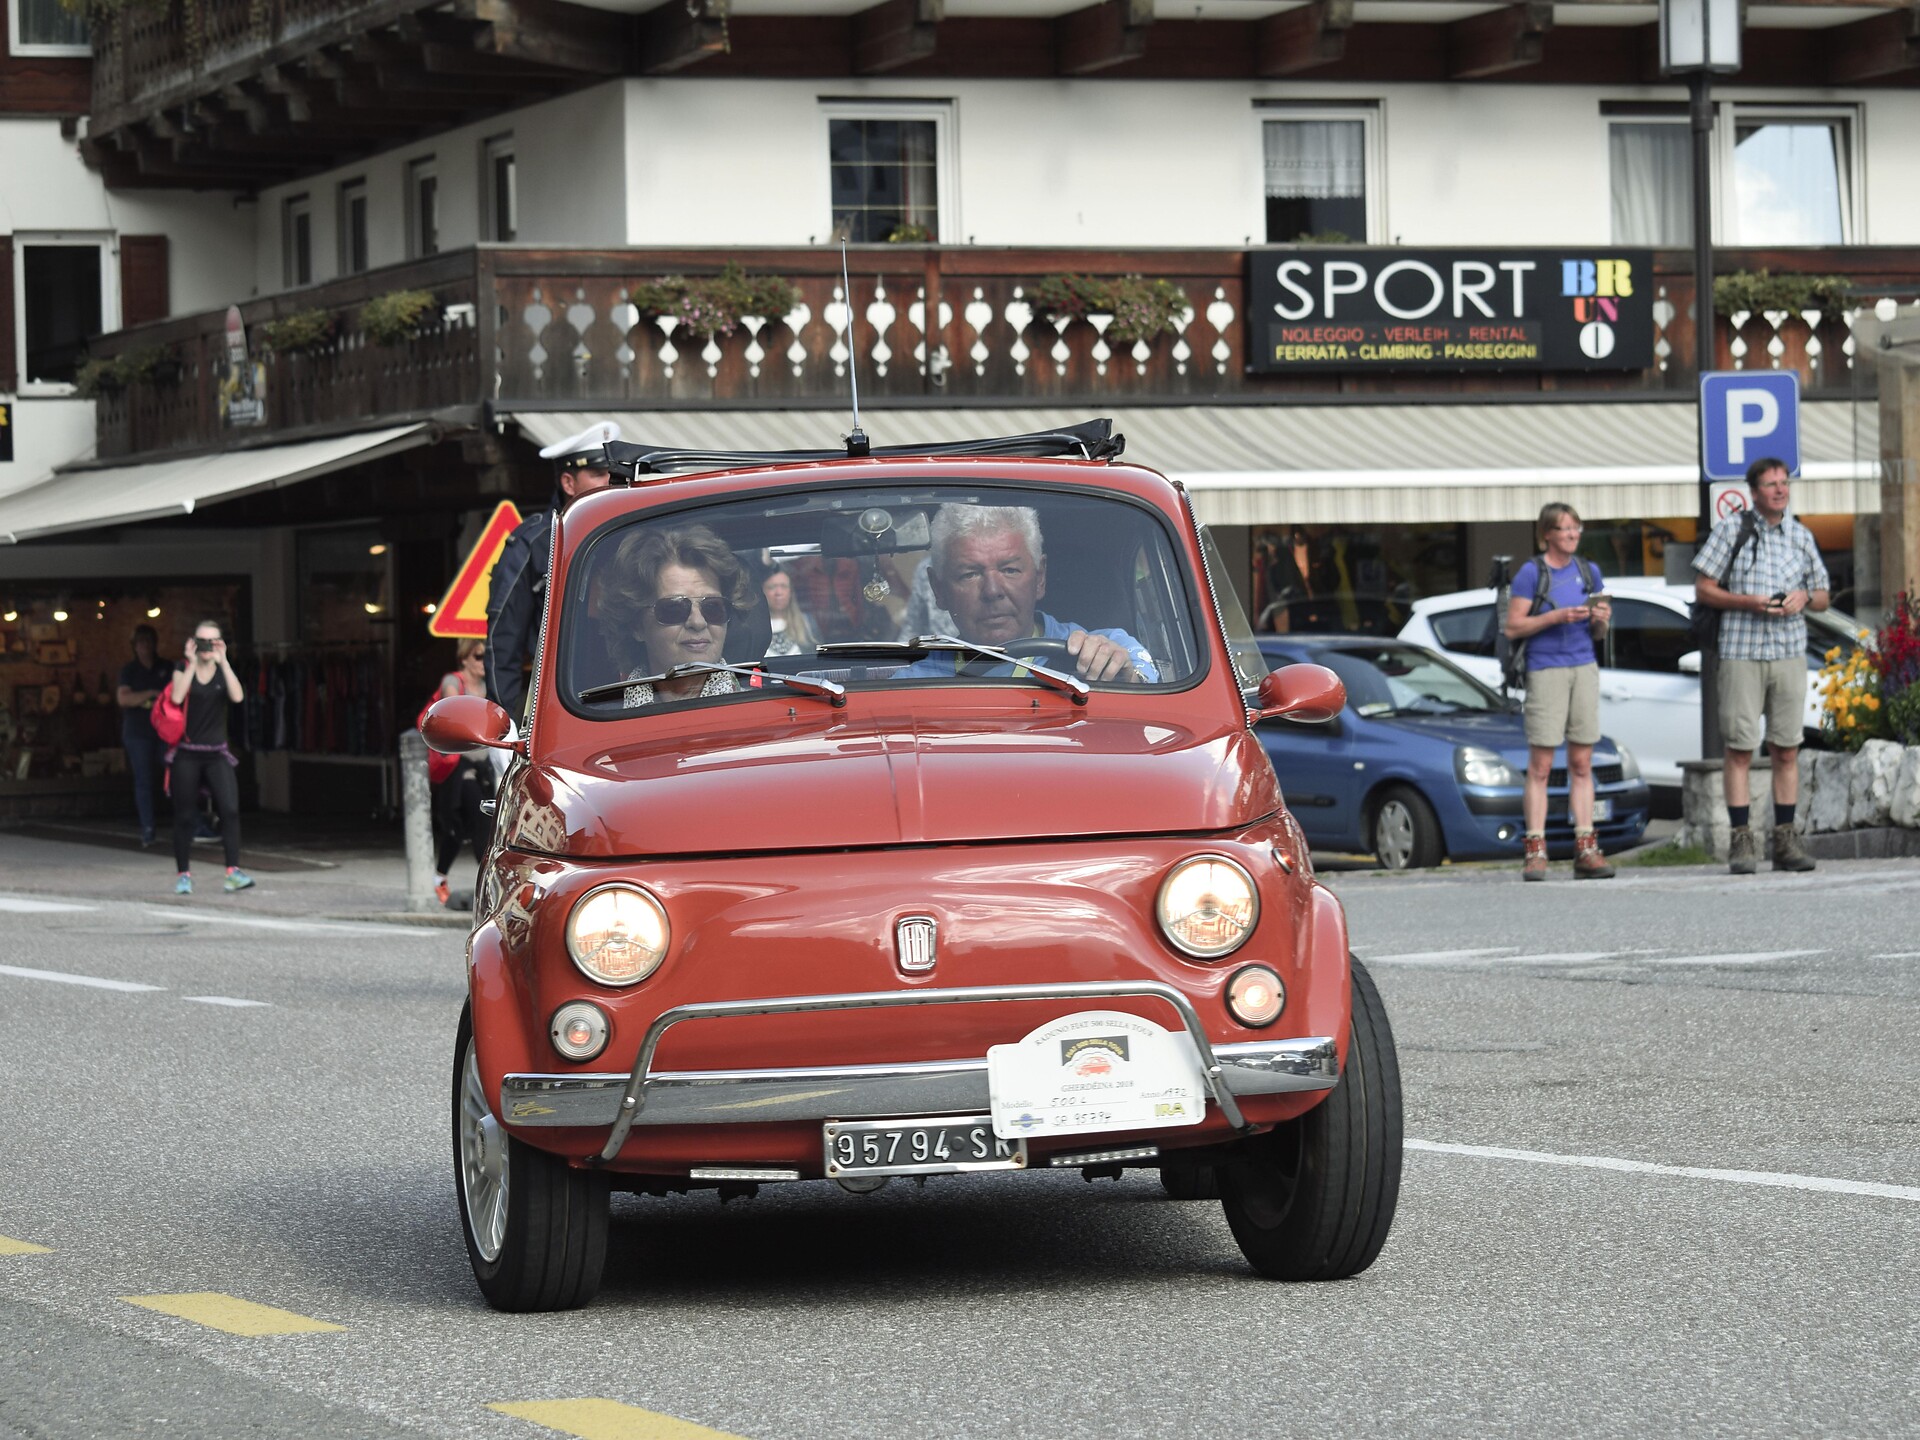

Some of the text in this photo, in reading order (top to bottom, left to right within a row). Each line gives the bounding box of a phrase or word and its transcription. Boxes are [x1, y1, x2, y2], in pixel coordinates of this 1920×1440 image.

[1274, 259, 1537, 320] SPORT
[1282, 326, 1364, 343] NOLEGGIO
[1384, 327, 1450, 342] VERLEIH
[1468, 326, 1527, 342] RENTAL
[1275, 344, 1349, 361] FERRATA
[1359, 344, 1433, 361] CLIMBING
[1444, 344, 1537, 360] PASSEGGINI
[1726, 388, 1780, 465] P
[1070, 1021, 1089, 1030] FIAT
[1105, 1020, 1129, 1028] SELLA
[1131, 1024, 1154, 1037] TOUR
[838, 1131, 950, 1165] 95794
